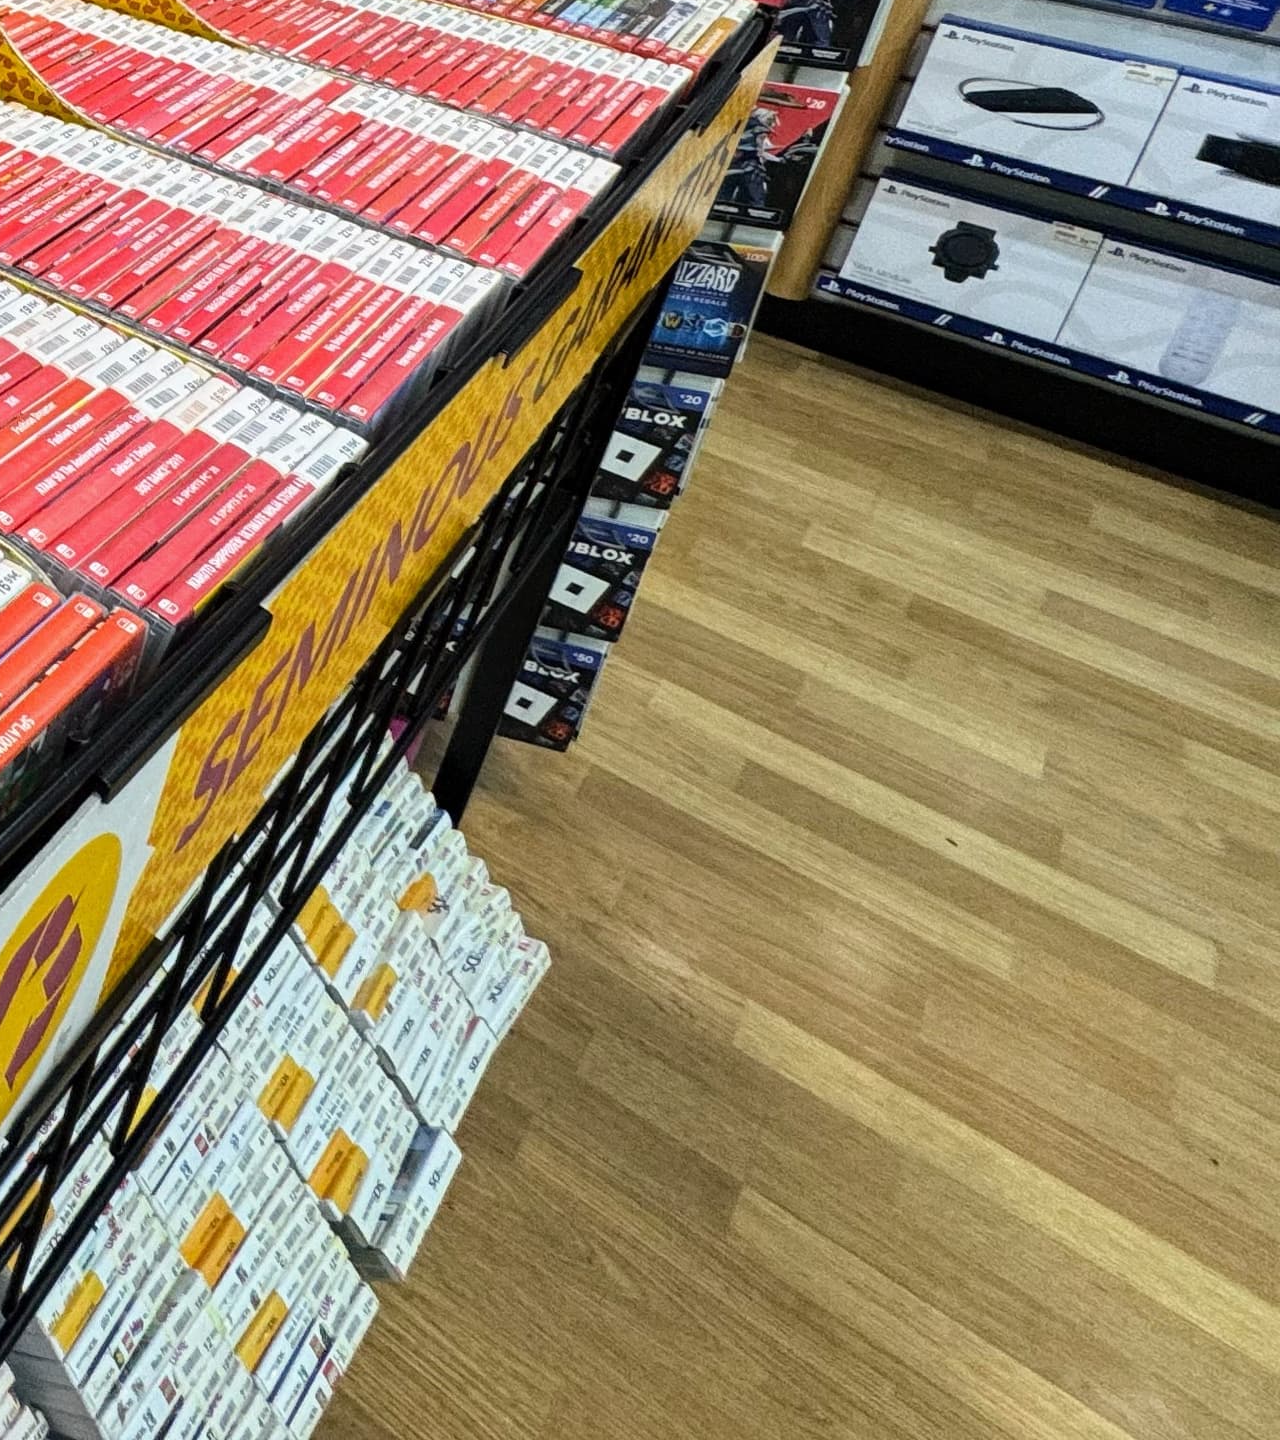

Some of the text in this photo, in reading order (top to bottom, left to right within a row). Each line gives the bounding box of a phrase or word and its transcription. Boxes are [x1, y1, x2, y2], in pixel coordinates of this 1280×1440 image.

[961, 30, 1017, 53] PlayStation
[1205, 86, 1270, 110] PlayStation
[990, 161, 1051, 184] PlayStation
[1175, 210, 1245, 236] PlayStation
[844, 290, 901, 311] PlayStation
[1009, 341, 1071, 366] PlayStation
[1137, 379, 1203, 408] PlayStation
[176, 380, 526, 854] SEMINOUS
[532, 116, 745, 410] GARANTITS
